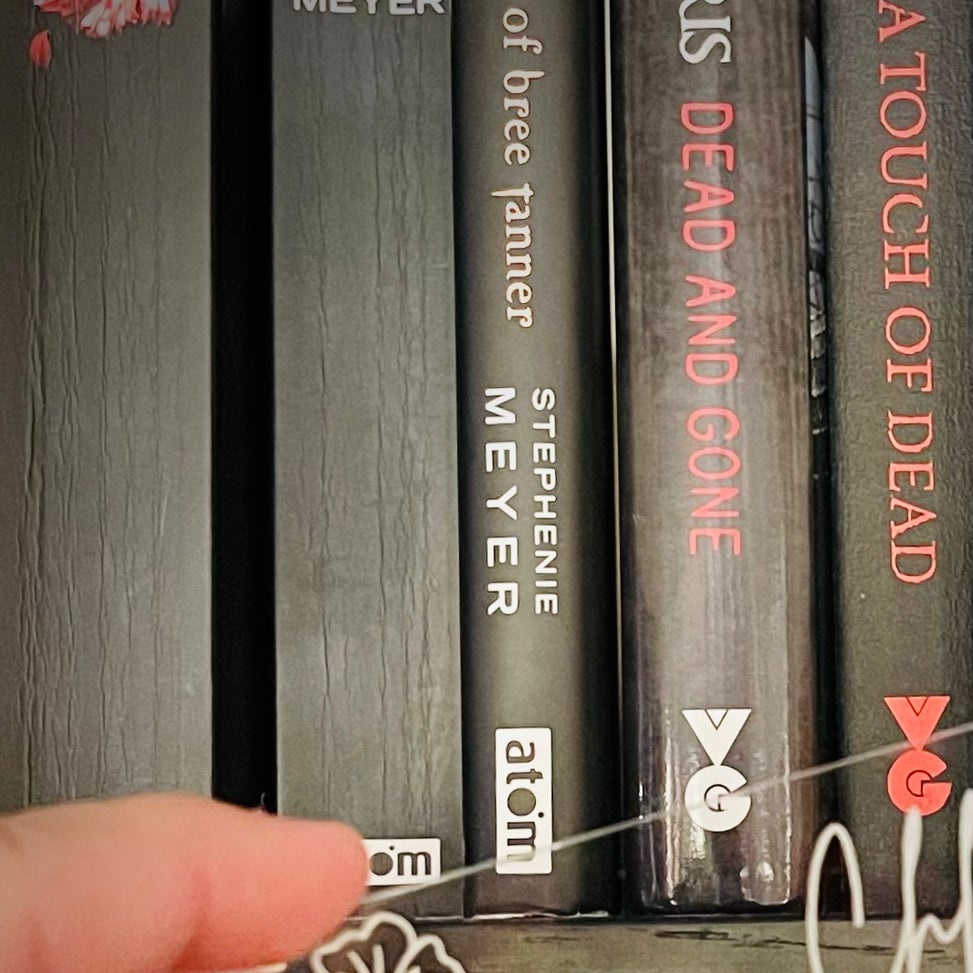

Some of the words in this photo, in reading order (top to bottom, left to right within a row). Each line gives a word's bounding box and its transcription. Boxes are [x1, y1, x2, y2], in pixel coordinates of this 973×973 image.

[503, 7, 543, 55] of
[878, 0, 926, 42] A
[503, 69, 545, 166] bree
[680, 102, 735, 252] DEAD
[879, 51, 930, 289] TOUCH
[491, 182, 534, 329] tanner
[684, 275, 737, 387] AND
[885, 306, 933, 393] OF
[485, 387, 519, 616] MEYER
[532, 387, 559, 615] STEPHENIE
[686, 407, 741, 556] GONE
[887, 411, 937, 584] DEAD
[505, 740, 546, 862] atom
